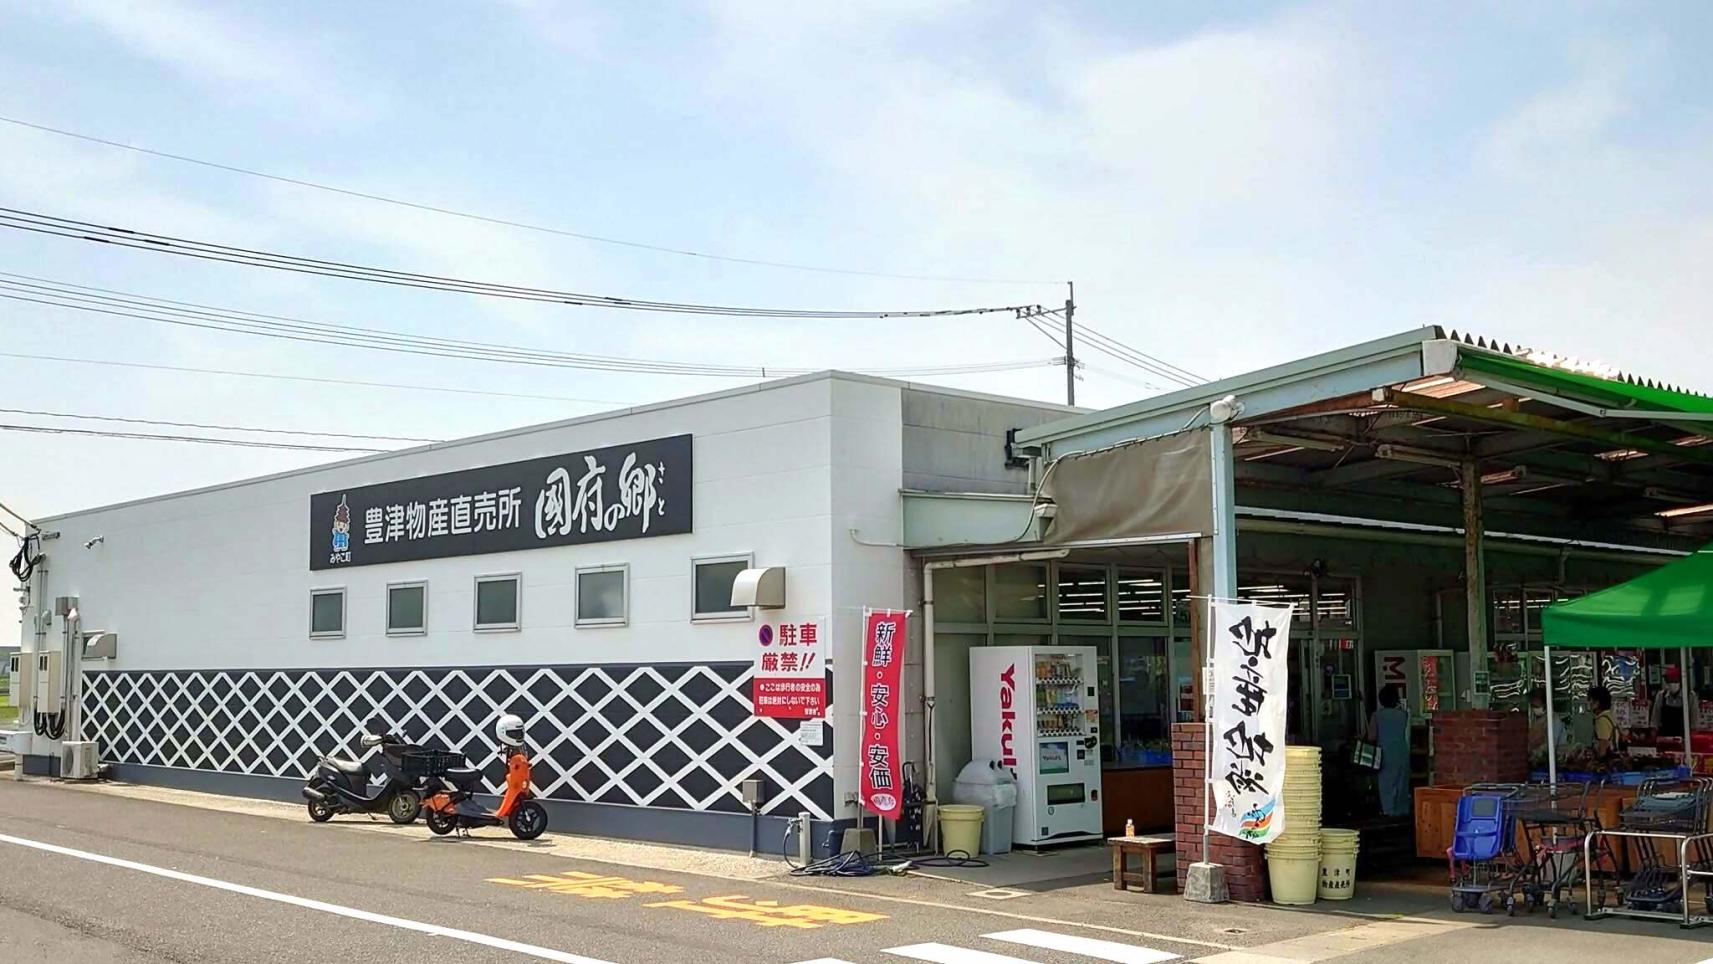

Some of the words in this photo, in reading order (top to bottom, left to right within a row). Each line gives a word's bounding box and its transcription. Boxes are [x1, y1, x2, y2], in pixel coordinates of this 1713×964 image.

[364, 486, 522, 545] 豊津物産直売所
[329, 551, 352, 564] みやこ町
[779, 623, 818, 647] 駐車
[868, 621, 896, 790] 新鮮・安心・安価
[1000, 663, 1017, 766] Yakul
